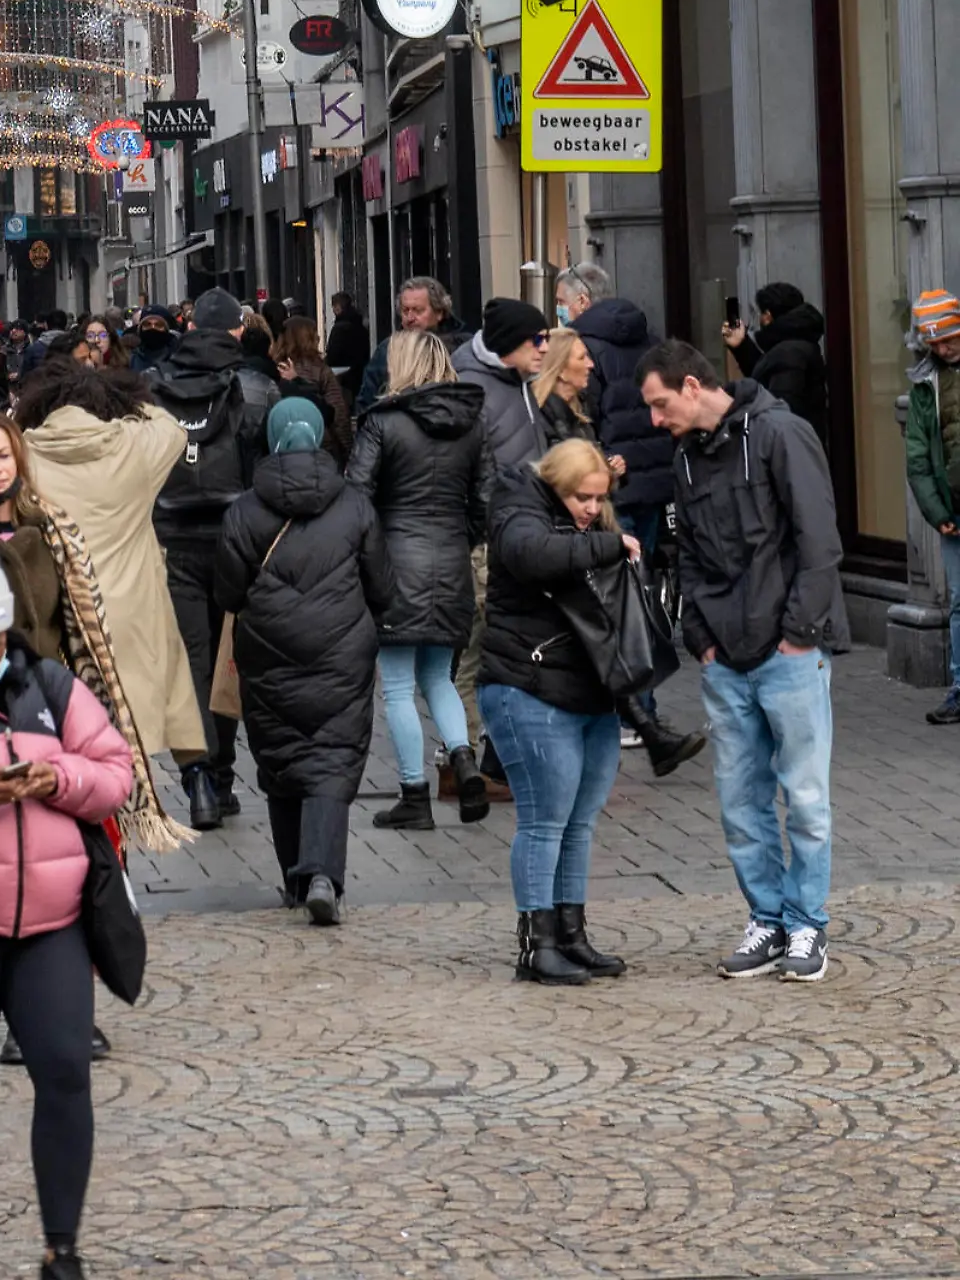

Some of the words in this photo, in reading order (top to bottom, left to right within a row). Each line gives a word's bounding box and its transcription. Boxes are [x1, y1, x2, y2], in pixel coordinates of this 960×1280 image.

[147, 108, 208, 126] NANA
[540, 114, 642, 132] beweegbaar
[554, 137, 627, 152] obstakel
